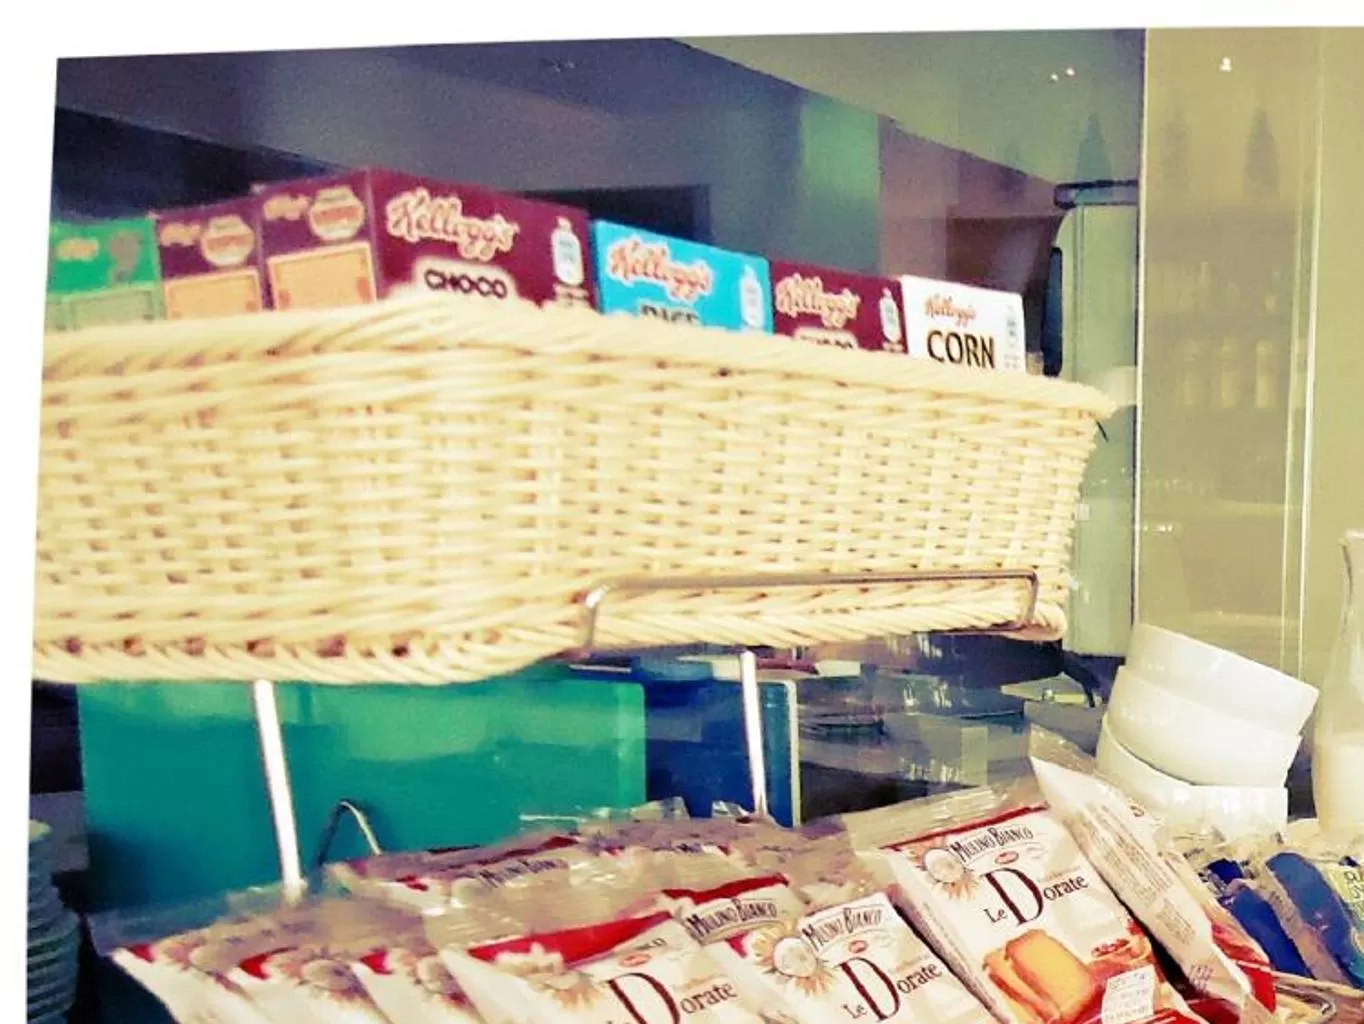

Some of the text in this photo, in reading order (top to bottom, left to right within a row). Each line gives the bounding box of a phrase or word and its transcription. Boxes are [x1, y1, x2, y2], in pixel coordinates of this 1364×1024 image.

[387, 188, 520, 262] Kellogg's
[927, 330, 996, 369] CORN
[984, 908, 1008, 923] Le
